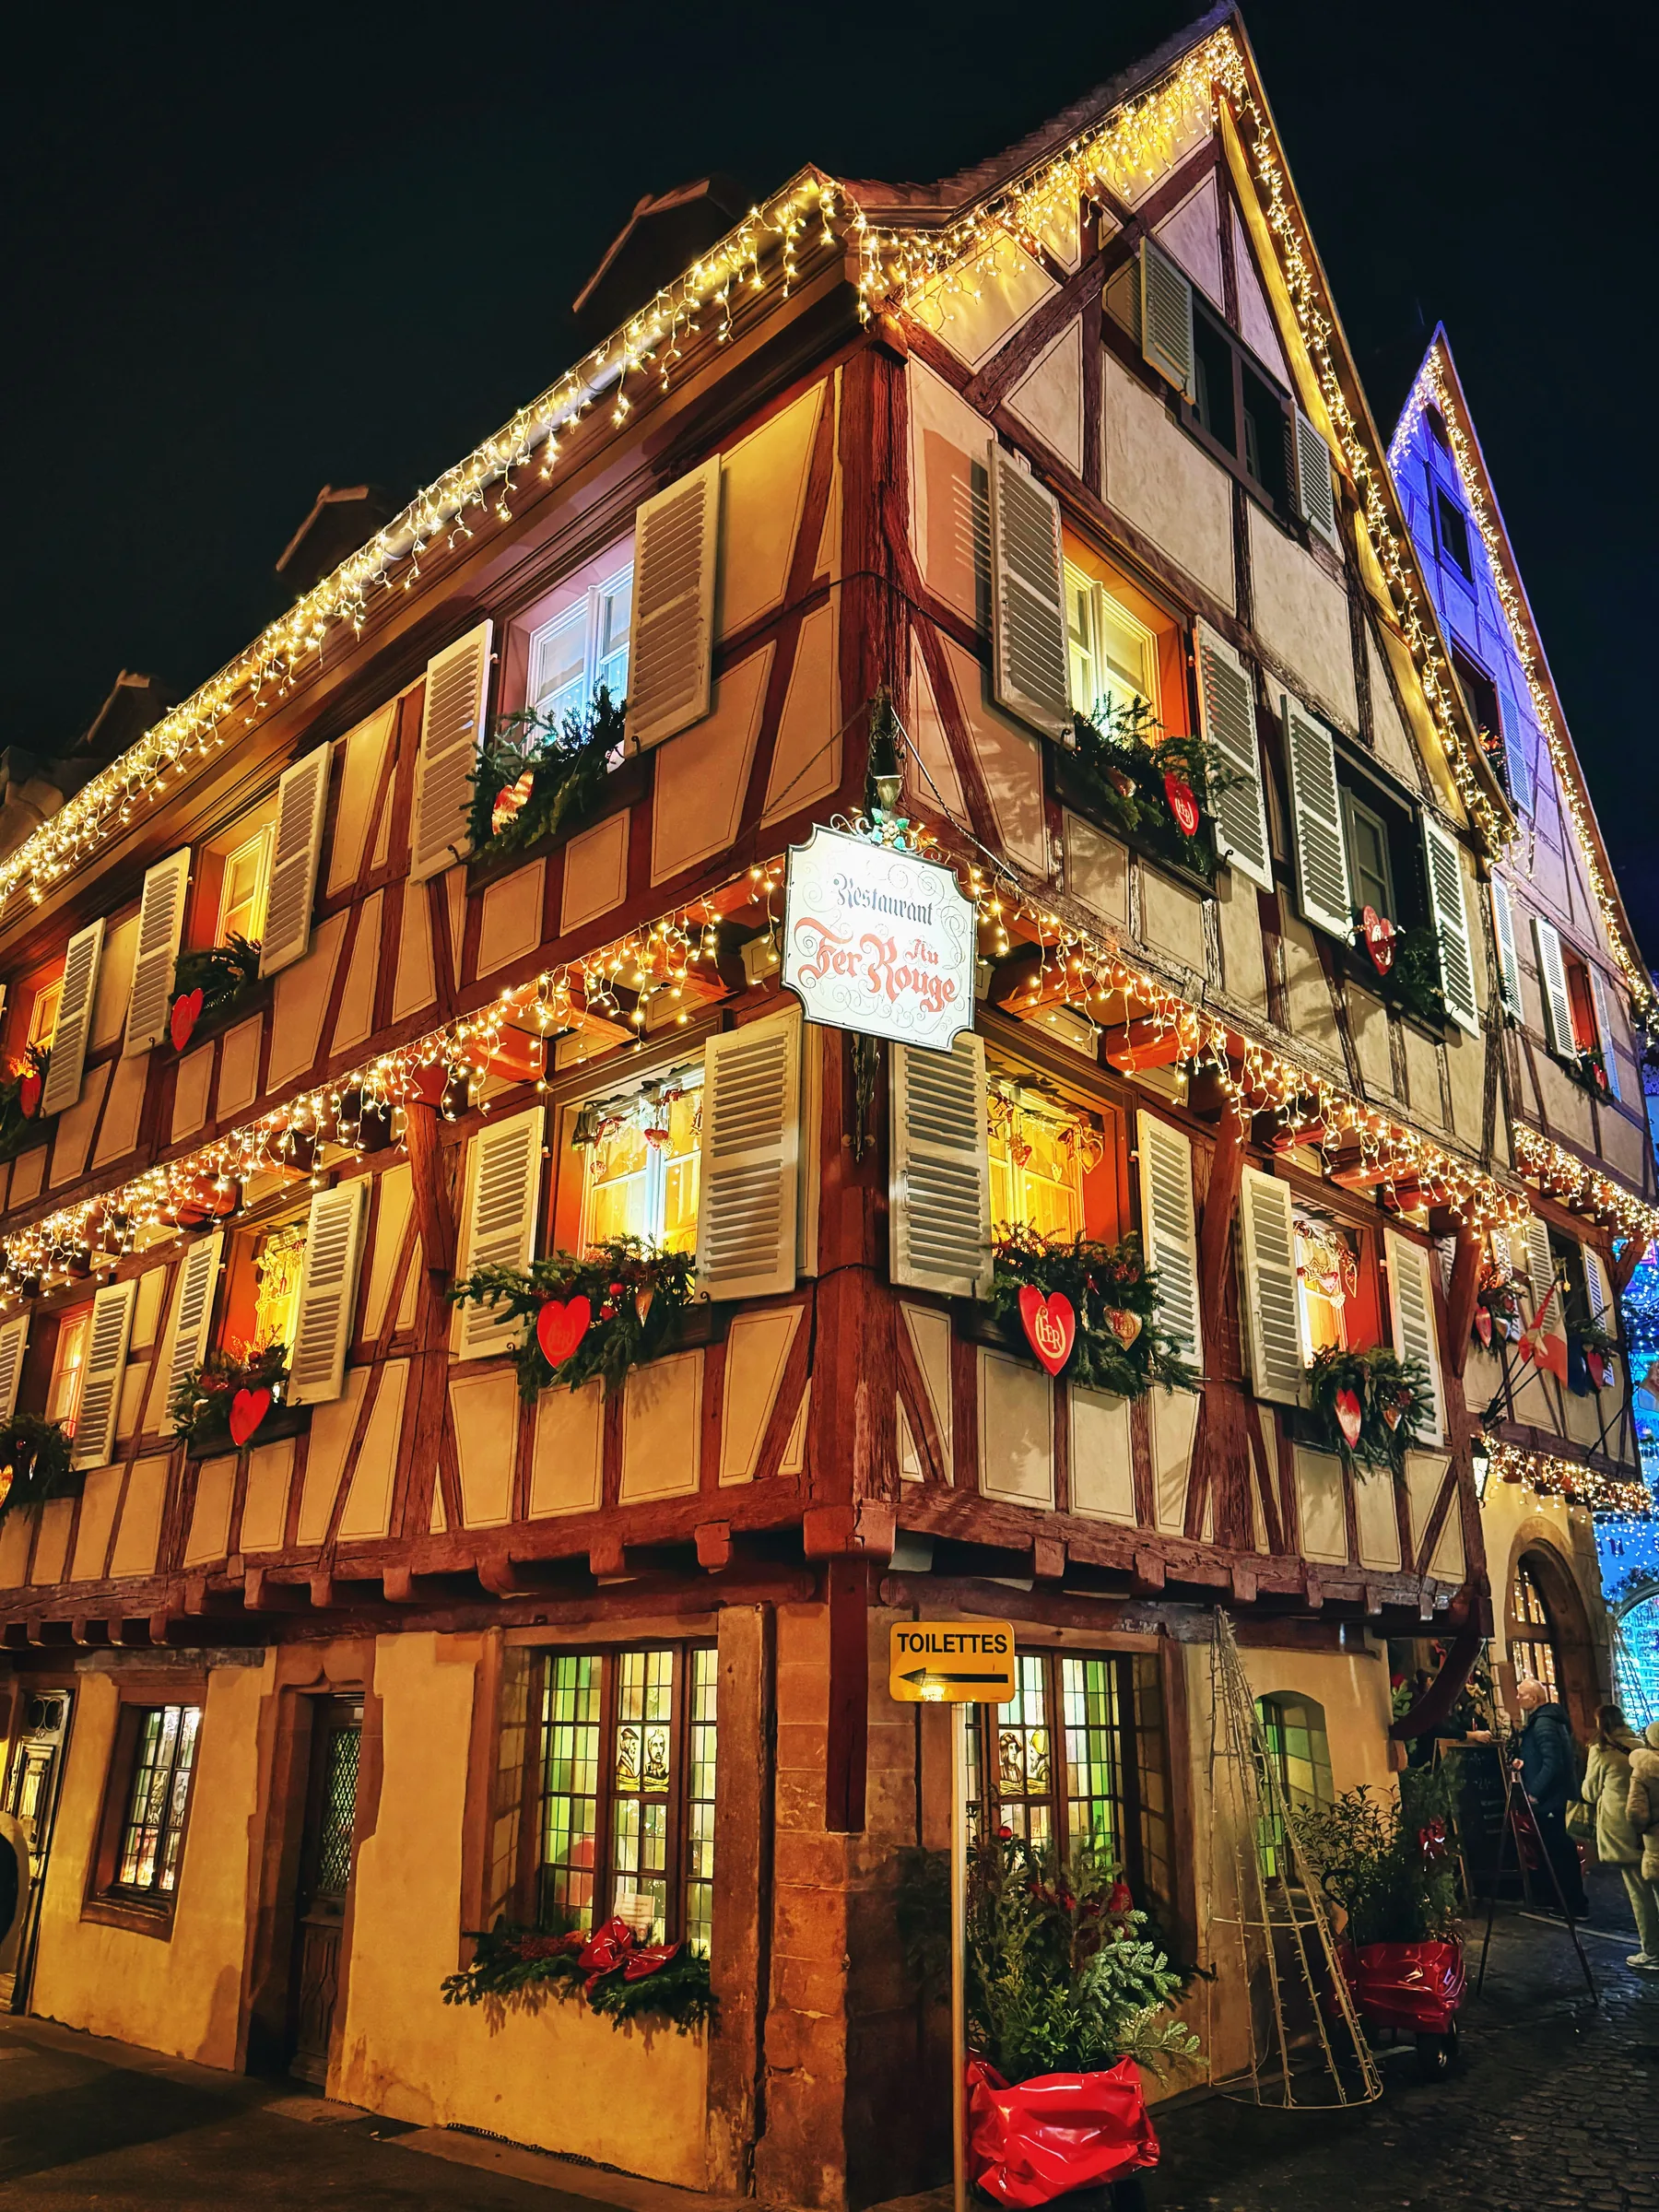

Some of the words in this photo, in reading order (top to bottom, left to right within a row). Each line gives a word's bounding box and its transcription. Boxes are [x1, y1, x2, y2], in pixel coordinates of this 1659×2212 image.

[833, 873, 933, 925] Restaurant
[794, 917, 862, 980] Fer
[860, 934, 958, 1012] Rouge
[905, 938, 938, 965] Au
[897, 1633, 1007, 1653] TOILETTES
